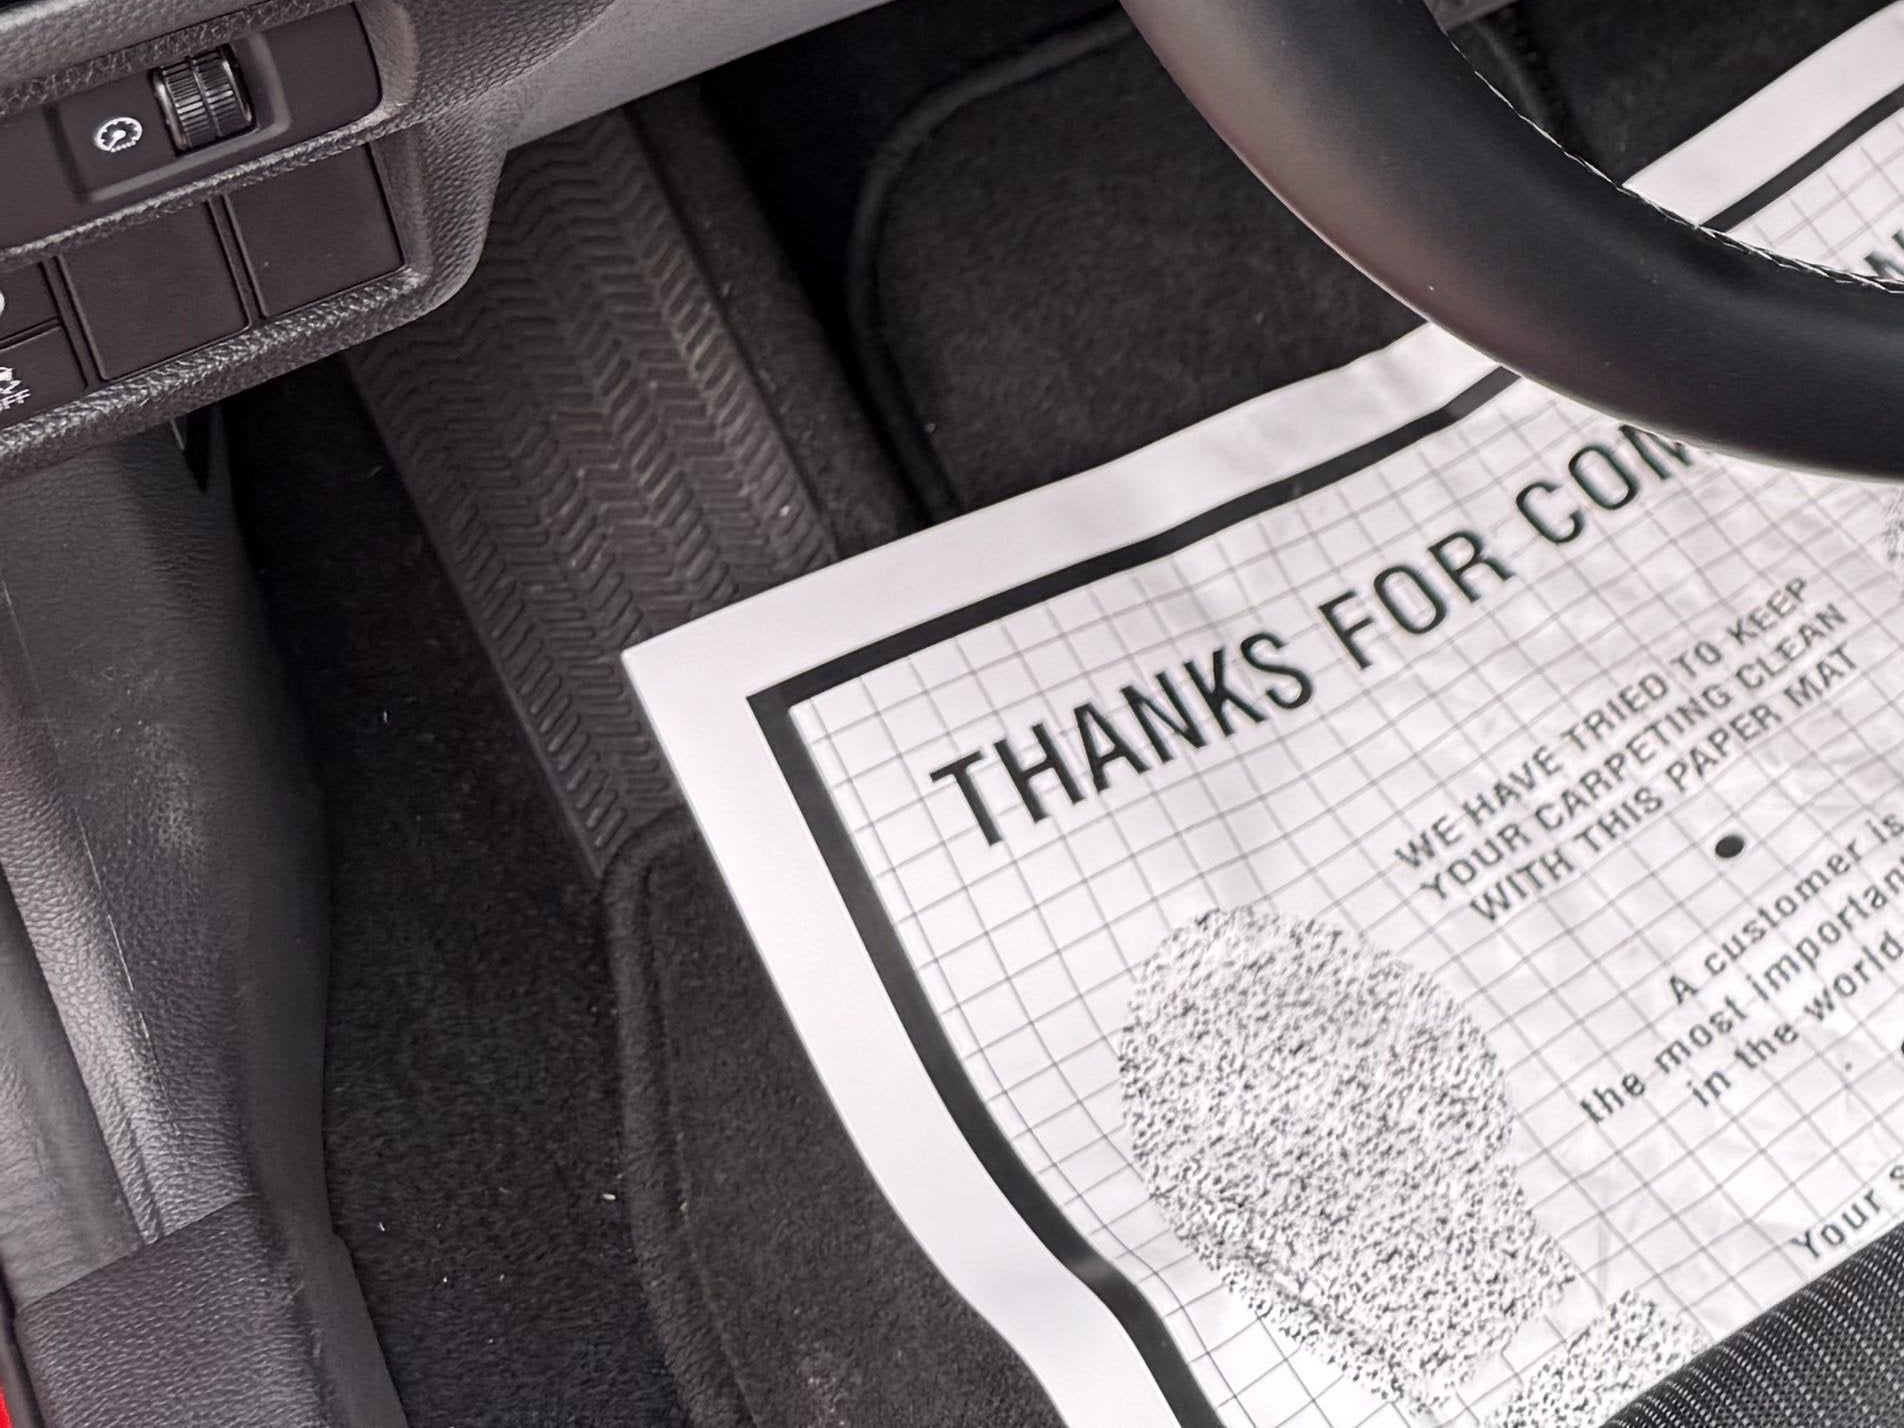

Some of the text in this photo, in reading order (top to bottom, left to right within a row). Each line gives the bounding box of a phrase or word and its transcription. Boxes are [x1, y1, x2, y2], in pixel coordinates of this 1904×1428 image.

[930, 631, 1318, 848] THANKS
[1318, 528, 1517, 671] FOR
[1394, 576, 1809, 872] WE HAVE TRIED TO KEEP
[1419, 602, 1851, 903] YOUR CARPETING CLEAN
[1468, 643, 1859, 926] WITH THIS PAPER MAT
[1667, 972, 1700, 1007] A
[1702, 839, 1863, 980] customer
[1578, 1070, 1648, 1127] the
[1652, 993, 1749, 1076] most
[1684, 1066, 1733, 1109] in
[1733, 1023, 1801, 1072] the
[1788, 1186, 1883, 1262] Your
